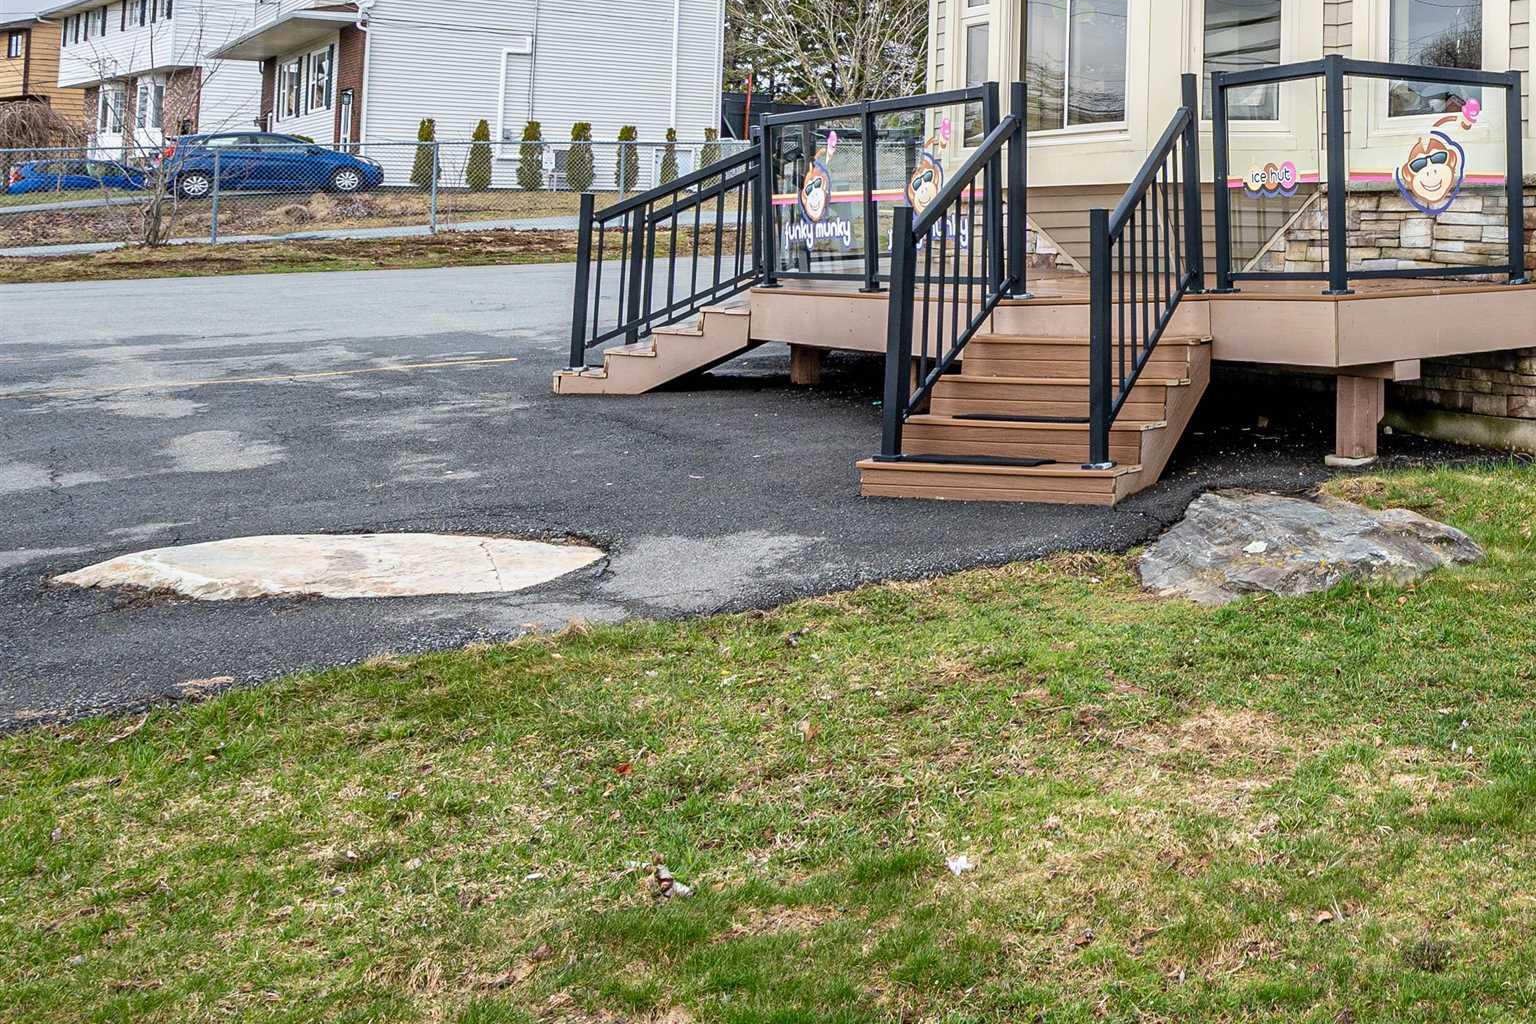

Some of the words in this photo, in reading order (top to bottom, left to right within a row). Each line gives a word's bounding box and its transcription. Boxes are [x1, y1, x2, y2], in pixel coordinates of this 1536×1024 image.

[1251, 170, 1266, 183] ice
[1270, 168, 1291, 182] hut
[784, 219, 814, 249] funky
[815, 216, 851, 247] munky
